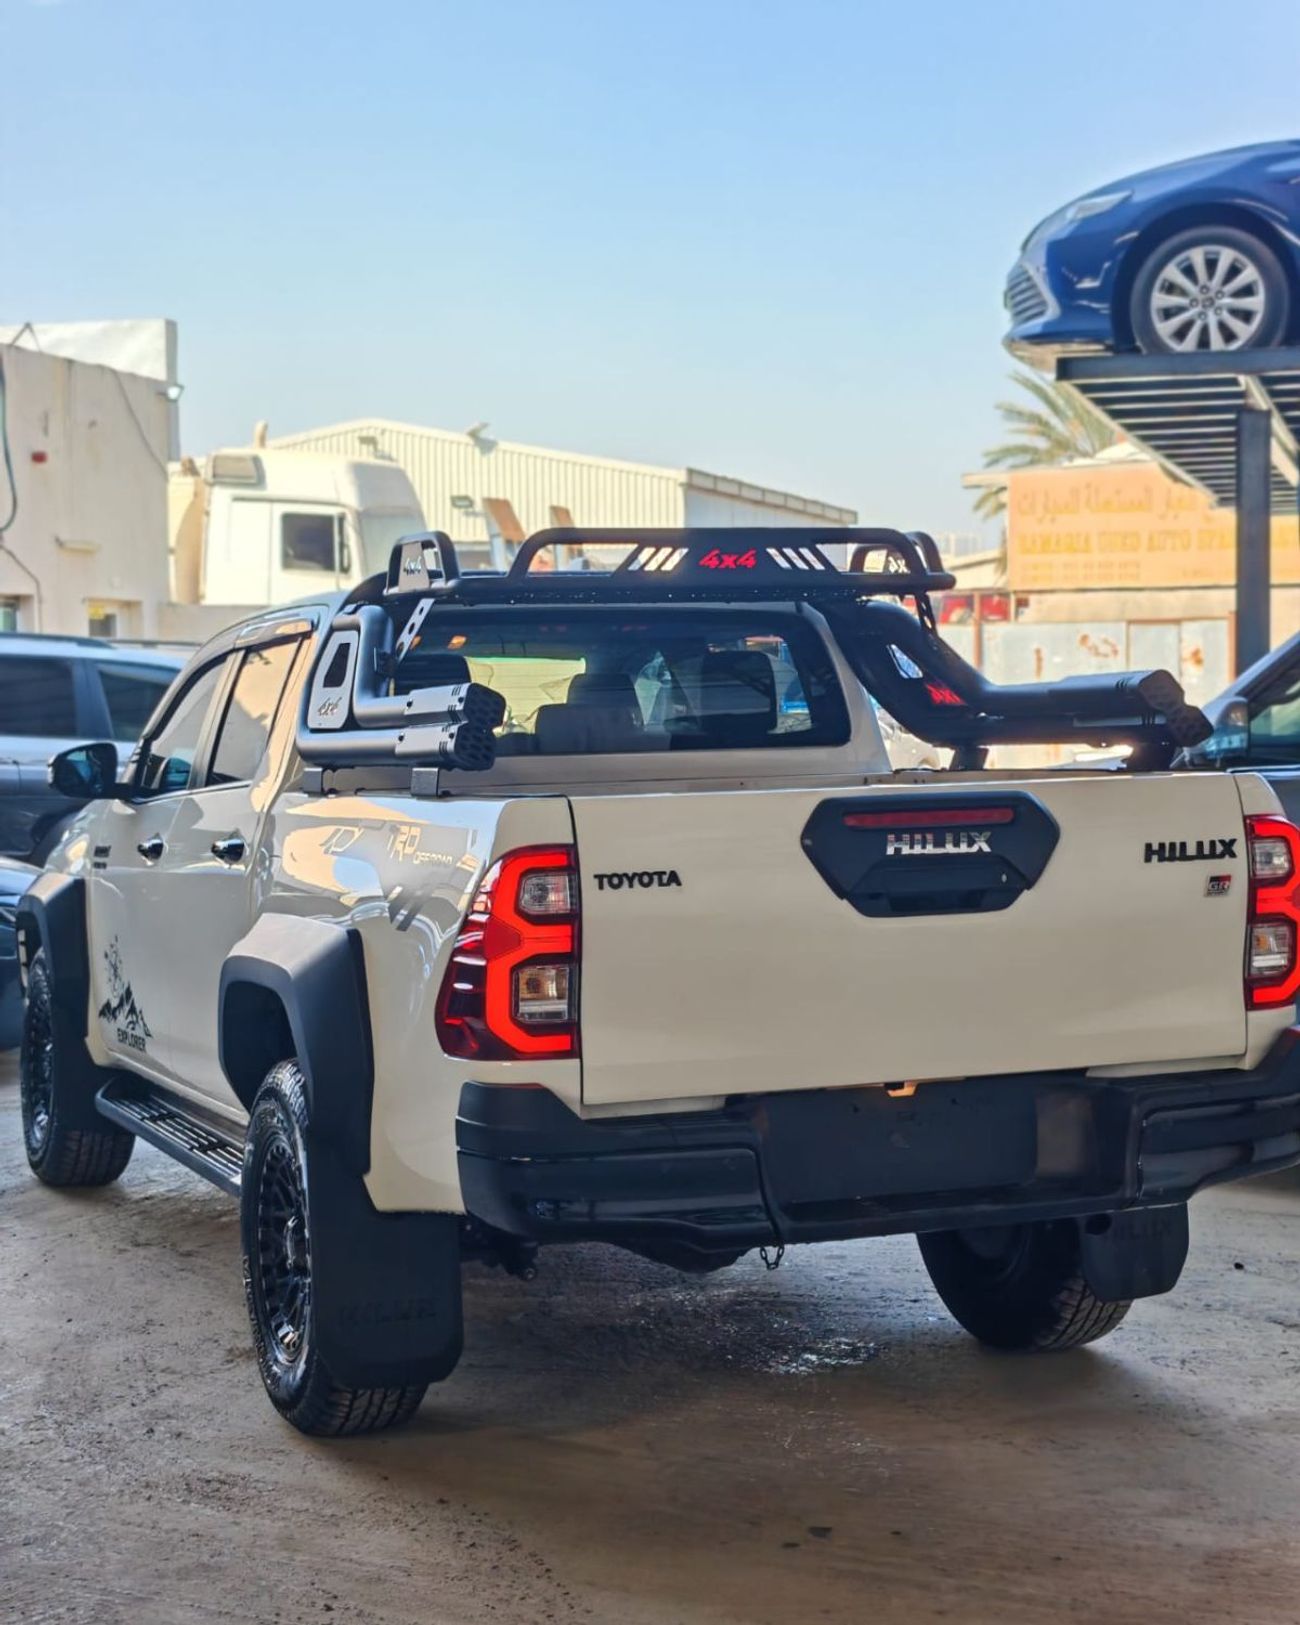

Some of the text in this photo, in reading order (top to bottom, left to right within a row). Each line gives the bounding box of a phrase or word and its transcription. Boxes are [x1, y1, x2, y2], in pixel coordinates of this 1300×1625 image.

[699, 548, 757, 569] 4x4
[886, 831, 992, 855] HILUX
[1144, 838, 1238, 863] HILUX
[593, 870, 682, 891] TOYOTA
[117, 1027, 146, 1053] EXPLORER
